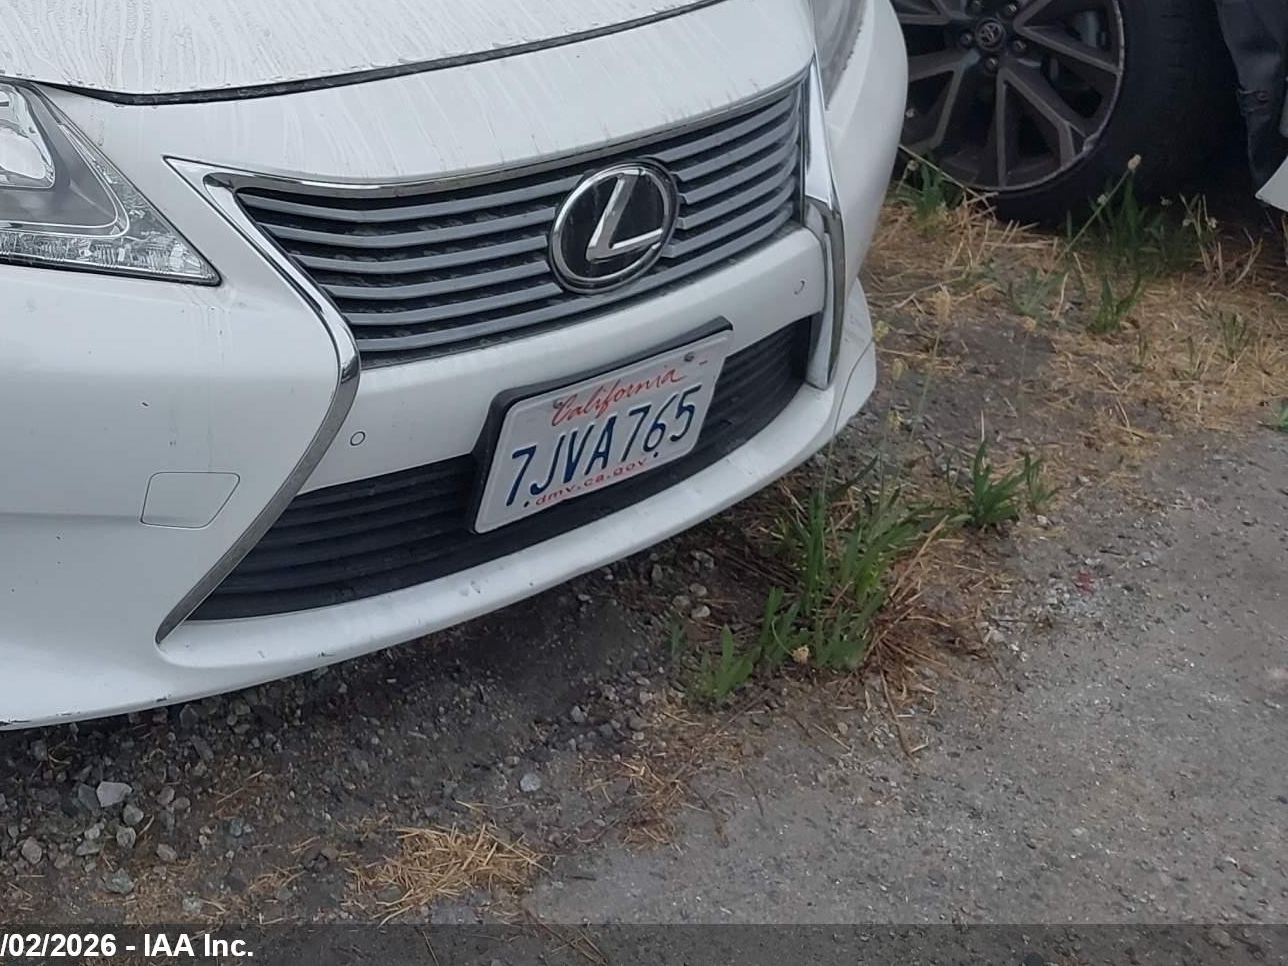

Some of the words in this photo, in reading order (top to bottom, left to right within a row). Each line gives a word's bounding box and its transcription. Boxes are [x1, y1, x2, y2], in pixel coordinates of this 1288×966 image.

[551, 365, 688, 427] California
[505, 384, 703, 507] 7JVA765
[535, 456, 648, 507] dmv.ca.gov
